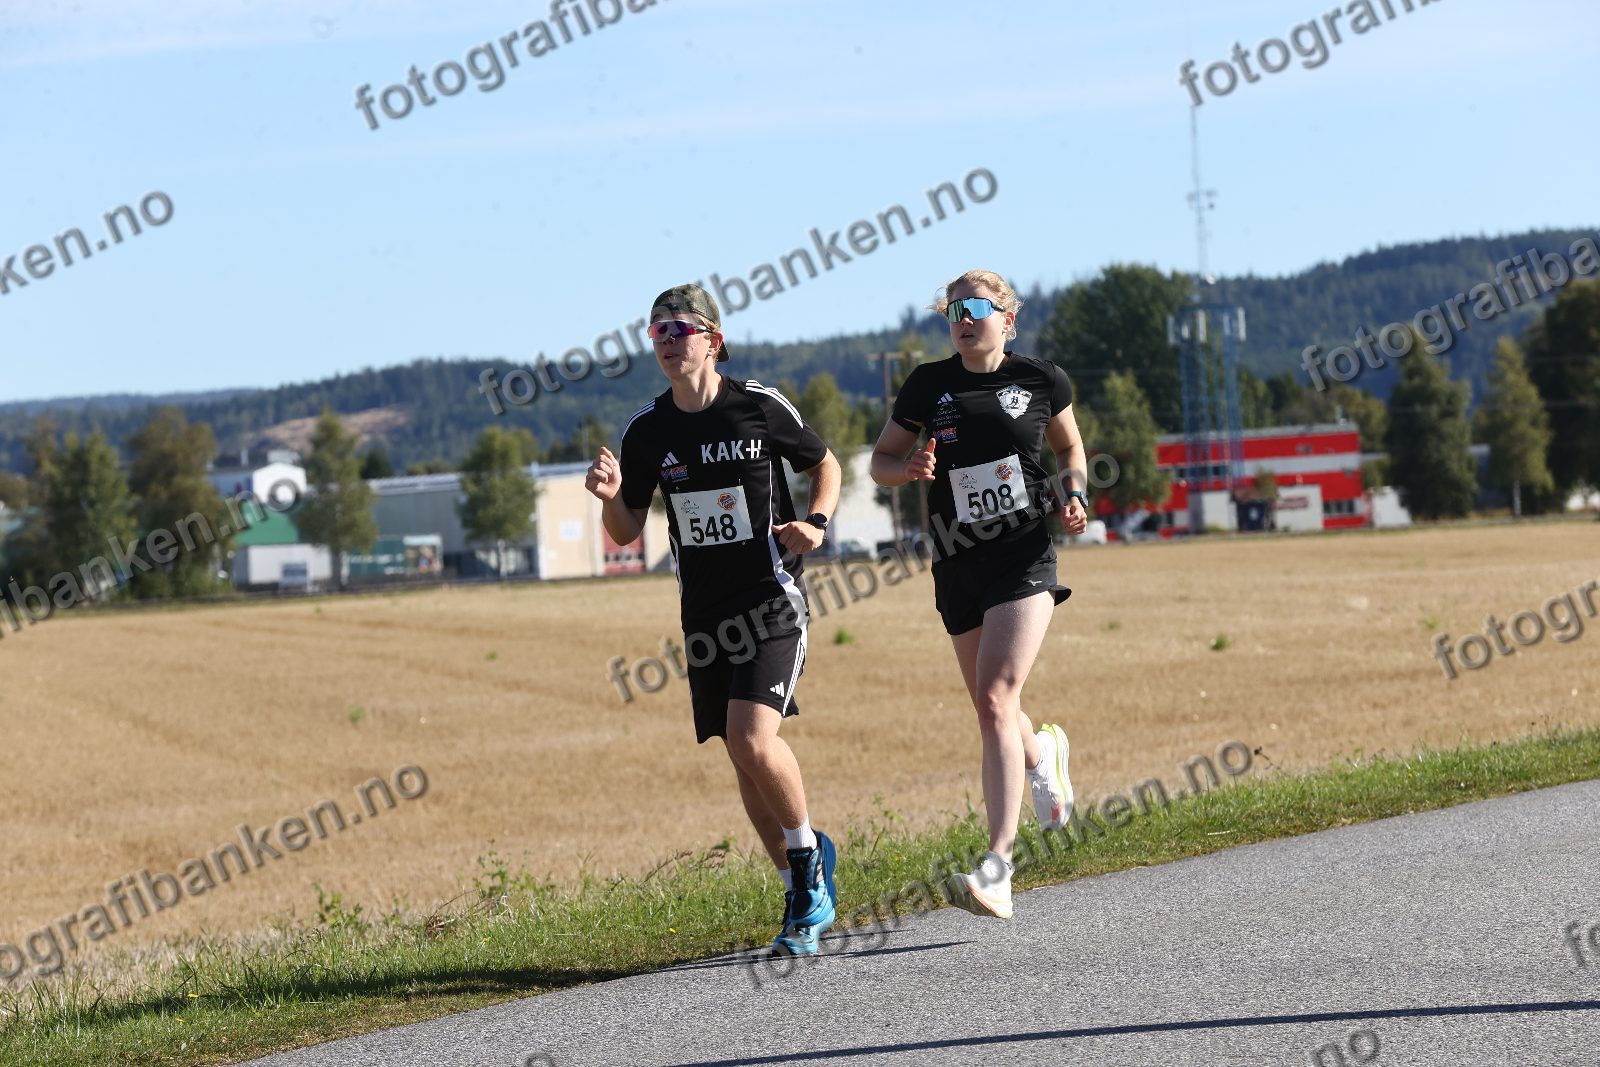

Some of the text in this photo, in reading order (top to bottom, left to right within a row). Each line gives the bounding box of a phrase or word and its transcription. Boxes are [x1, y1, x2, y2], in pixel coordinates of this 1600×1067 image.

[701, 439, 762, 464] KAK-H
[968, 483, 1015, 519] 508
[690, 513, 738, 544] 548
